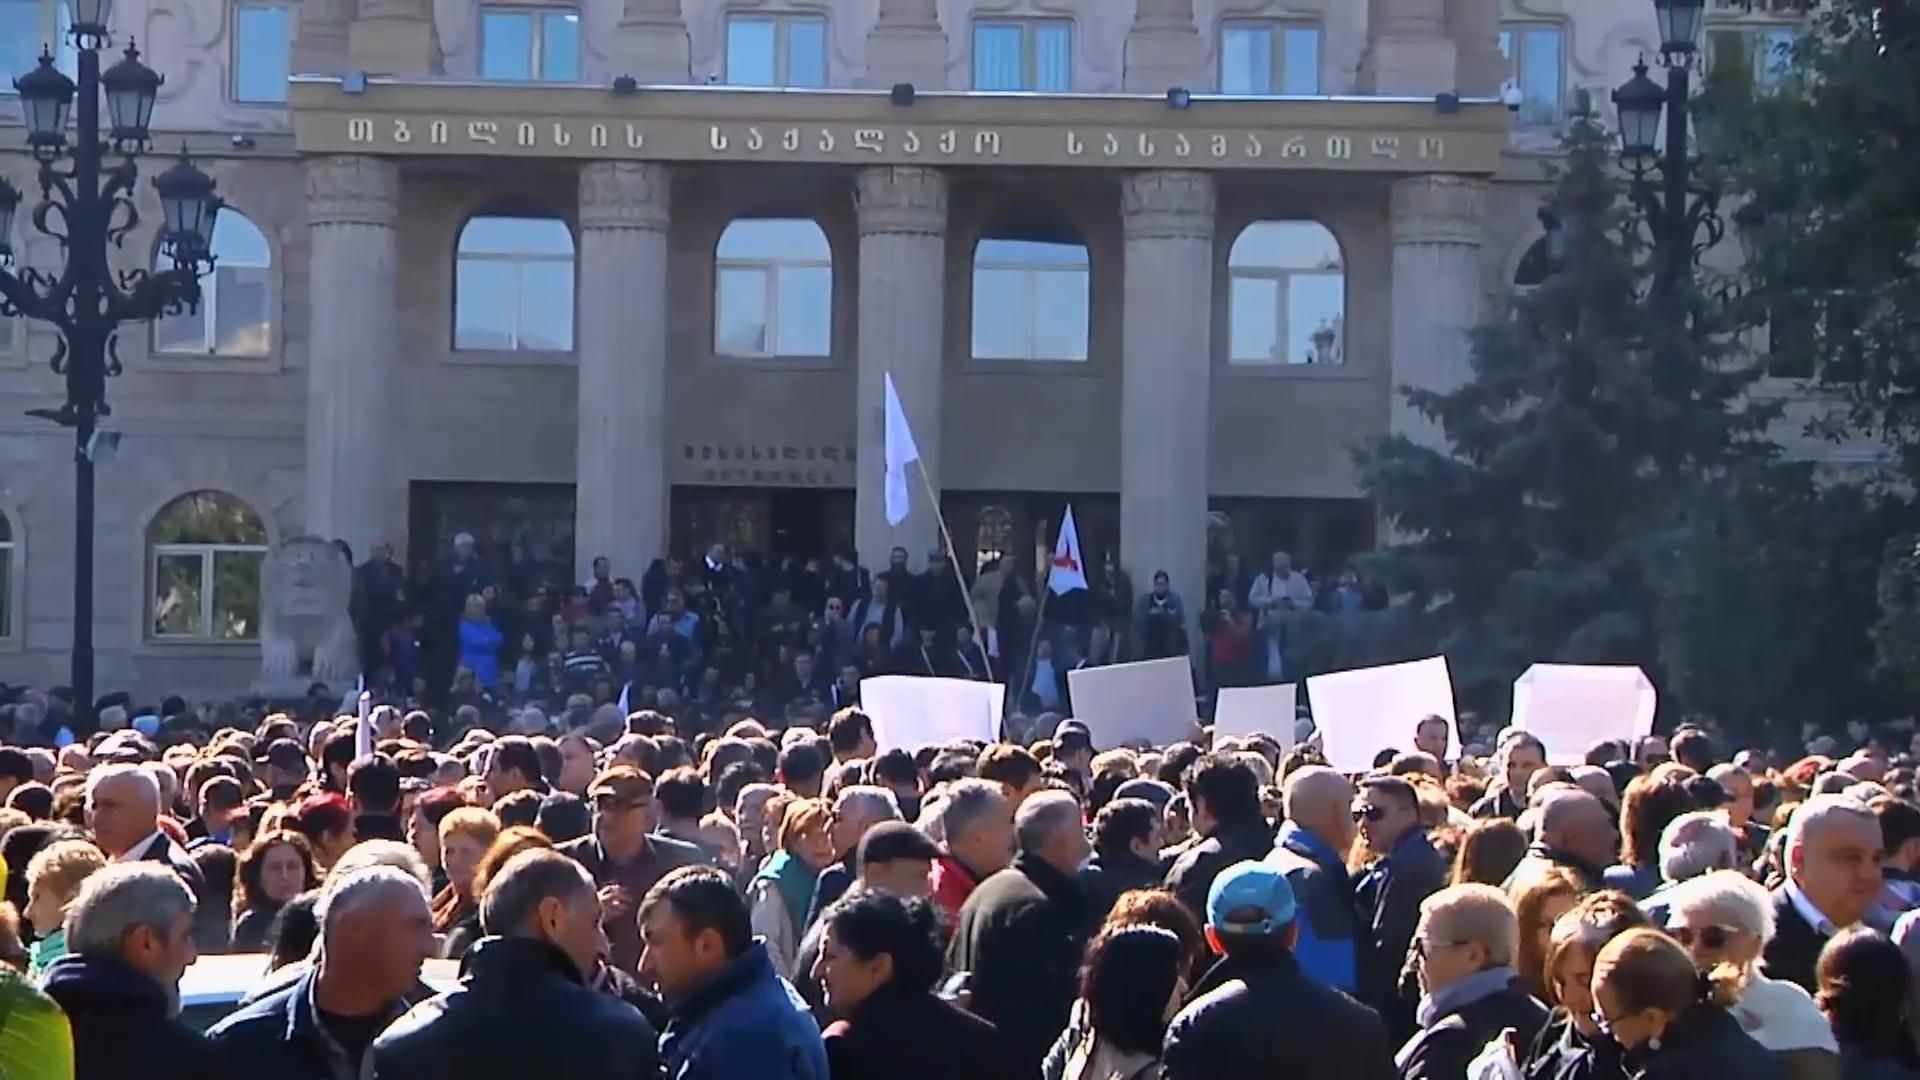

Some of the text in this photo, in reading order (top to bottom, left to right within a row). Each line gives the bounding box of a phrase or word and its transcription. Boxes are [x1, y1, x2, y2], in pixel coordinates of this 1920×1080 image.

[348, 117, 1446, 160] თბილისის საქალაქო სასამართლო
